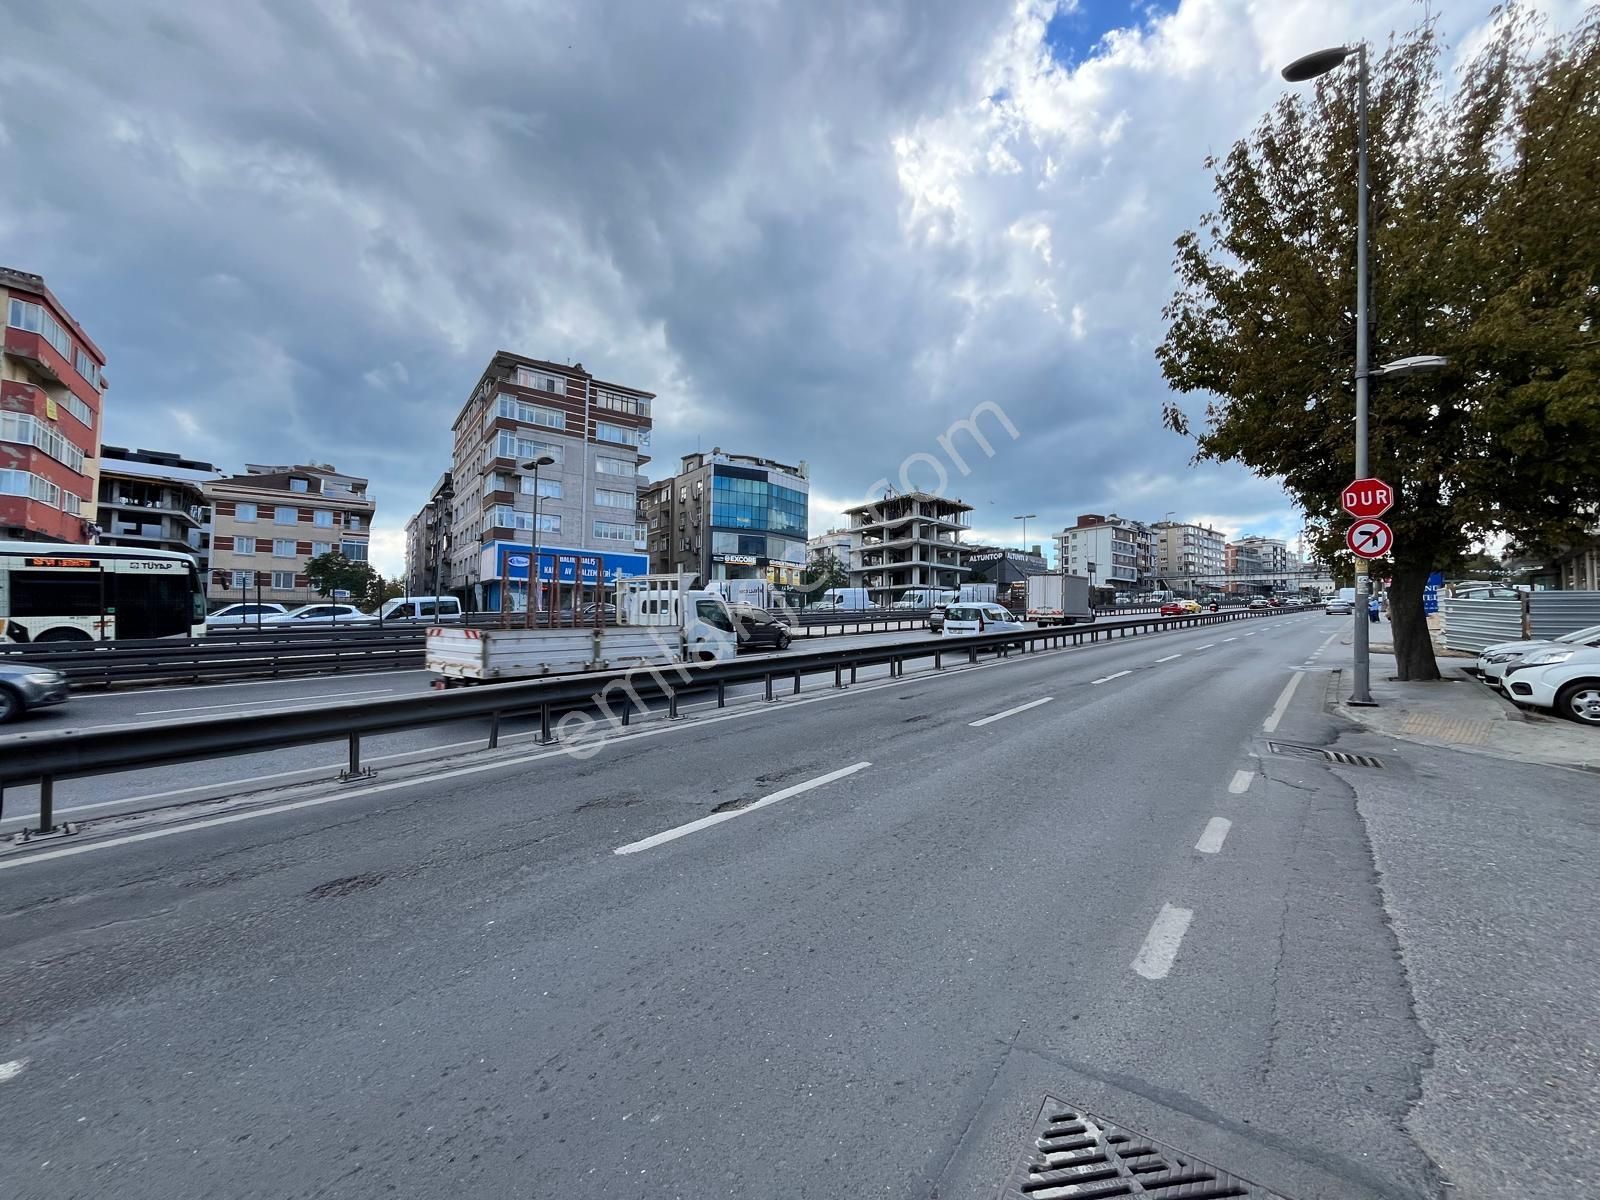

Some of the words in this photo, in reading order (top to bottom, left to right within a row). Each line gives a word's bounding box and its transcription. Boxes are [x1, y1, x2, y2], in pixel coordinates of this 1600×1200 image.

[1346, 490, 1387, 507] DUR
[969, 552, 1003, 562] ALTUNTOP
[1007, 552, 1029, 562] ALTUNTP
[141, 562, 172, 570] TÜYAP
[564, 567, 573, 575] AV
